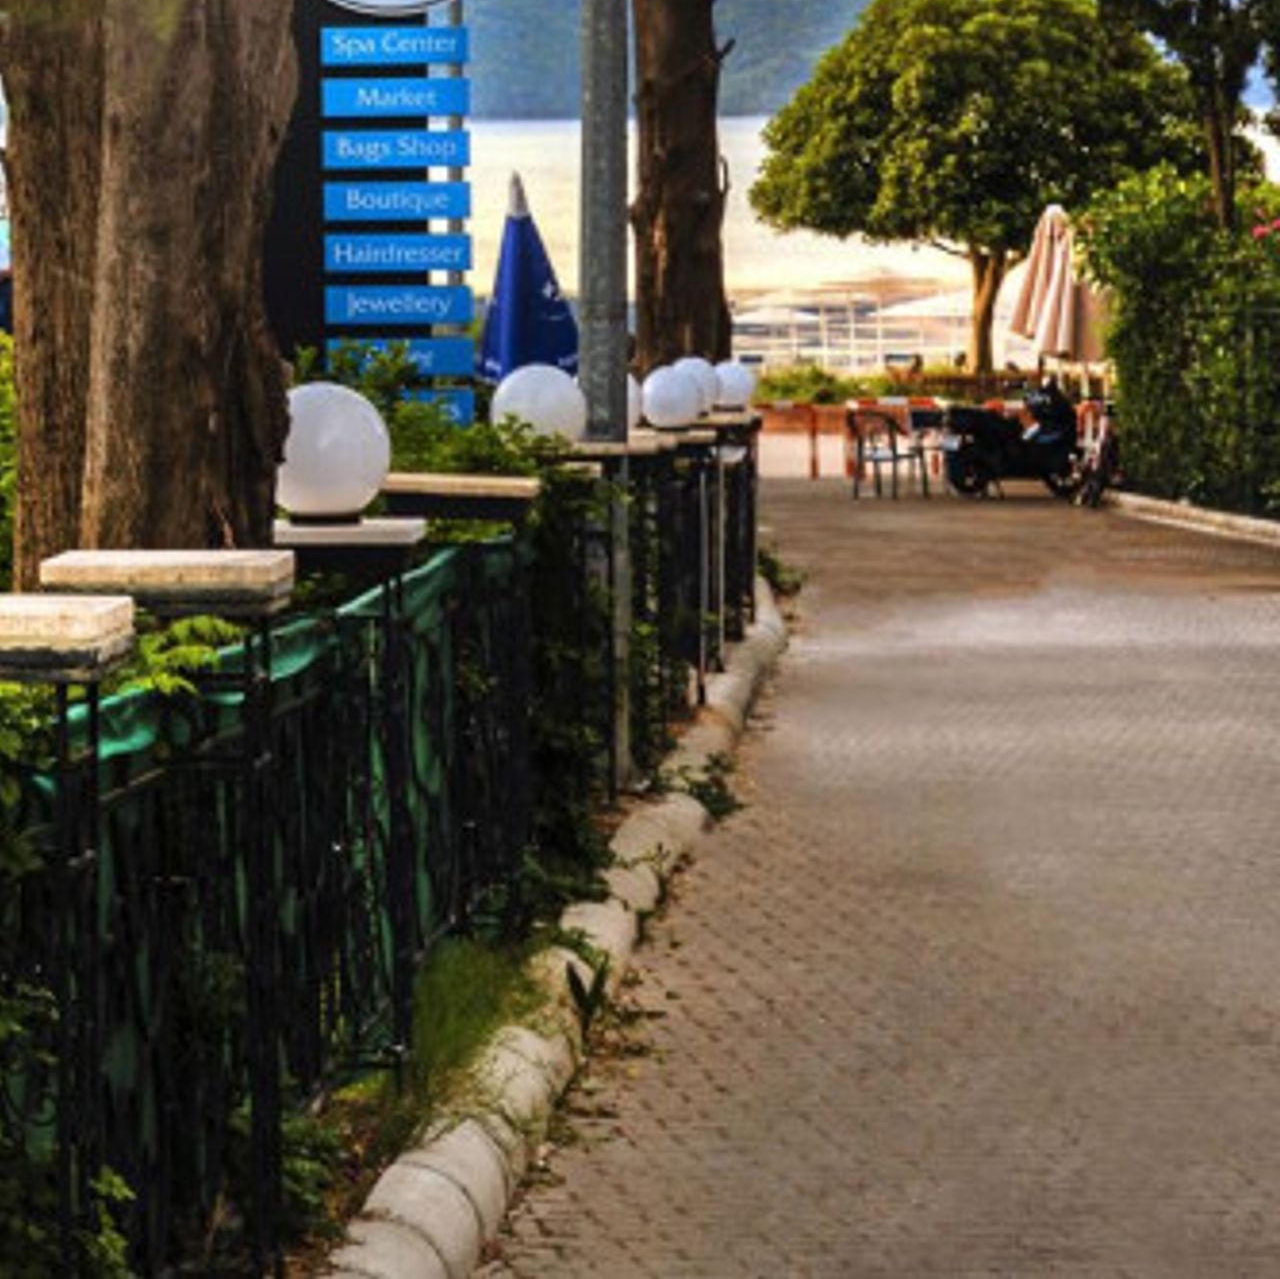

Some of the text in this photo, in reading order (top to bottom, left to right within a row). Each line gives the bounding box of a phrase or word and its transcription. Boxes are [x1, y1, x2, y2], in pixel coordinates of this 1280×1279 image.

[330, 30, 457, 58] Spa Center
[356, 86, 438, 109] Market
[336, 135, 457, 163] Bags Shop
[345, 188, 450, 214] Boutique
[332, 241, 463, 265] Hairdresser
[345, 291, 454, 318] Jewellery
